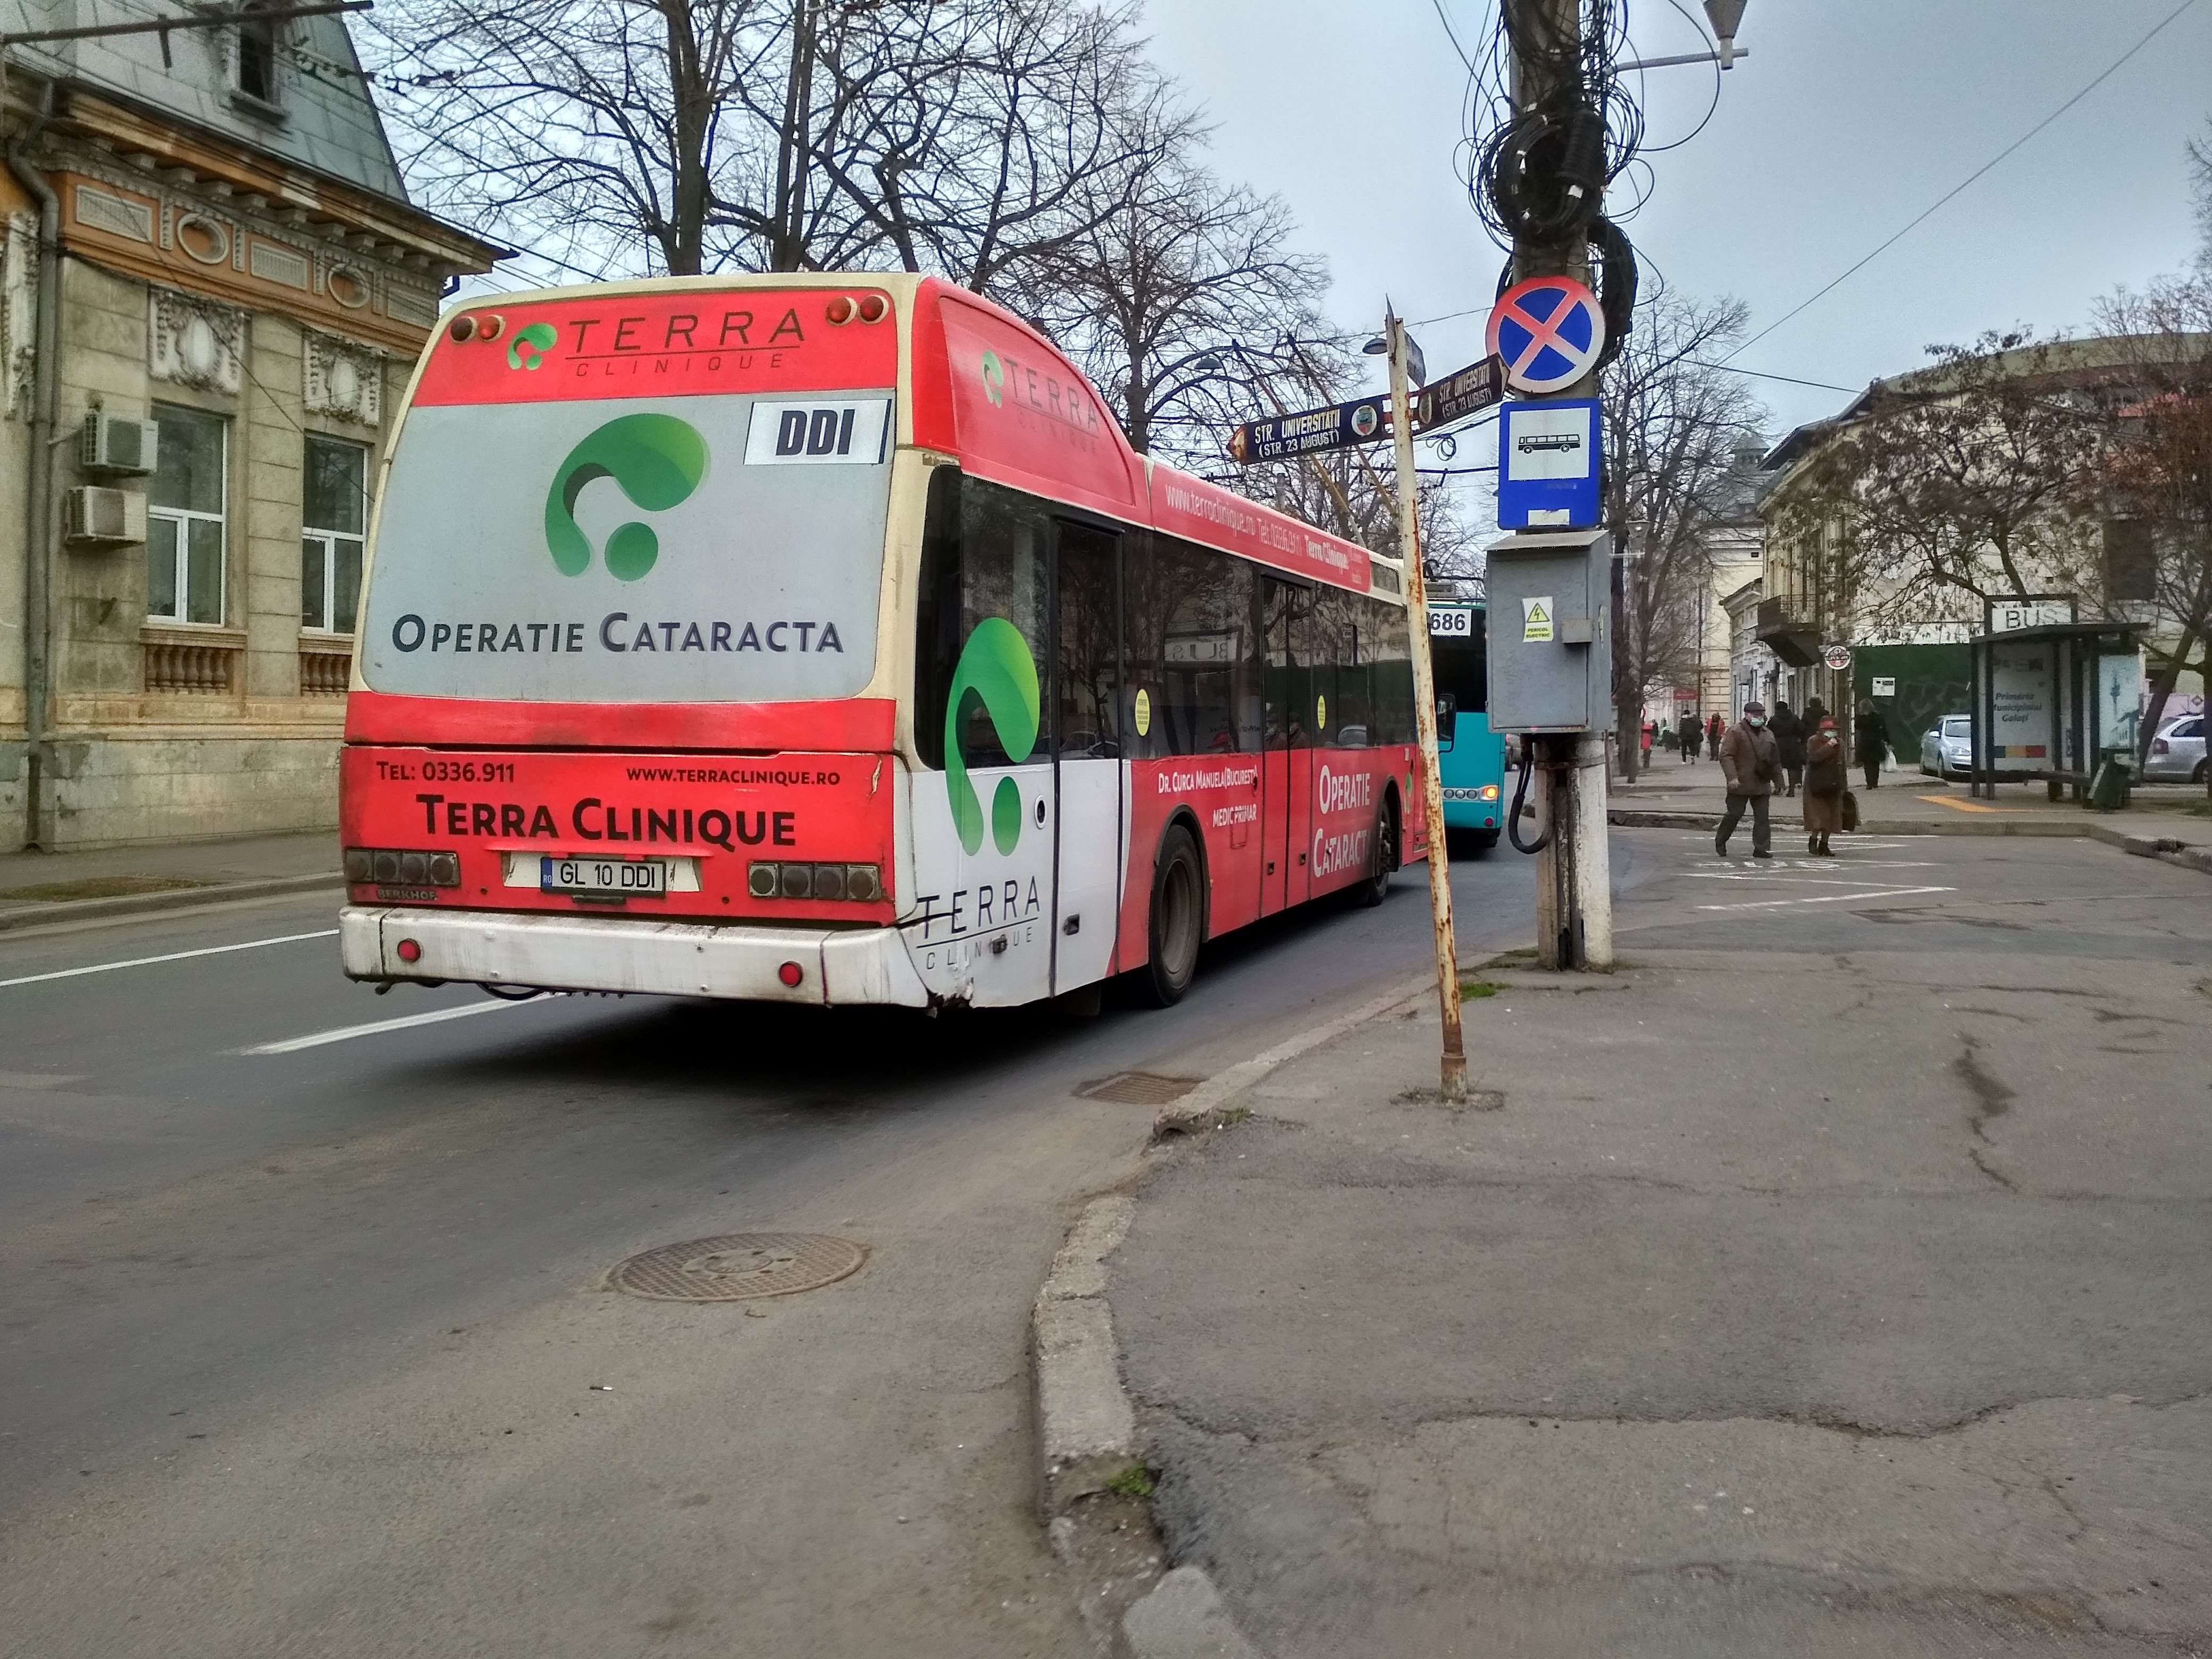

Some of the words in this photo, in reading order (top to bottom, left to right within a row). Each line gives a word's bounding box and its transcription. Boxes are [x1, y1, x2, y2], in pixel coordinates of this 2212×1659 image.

[569, 308, 805, 354] TERRA
[576, 353, 783, 377] CLINIQUE
[1004, 357, 1100, 434] TERRA
[1458, 397, 1467, 410] 23
[776, 409, 855, 456] DDI
[1255, 424, 1275, 444] STR.
[1259, 441, 1284, 459] (STR.
[1286, 439, 1298, 452] 23
[1301, 429, 1339, 450] AUGUST)
[1165, 484, 1256, 537] www.terraclinique.ro
[1304, 535, 1323, 562] Terra
[1322, 541, 1350, 575] Clinique
[392, 614, 584, 652] OPERATIE
[599, 612, 844, 653] CATARACTA
[2006, 608, 2058, 629] BUS
[376, 761, 415, 780] TEL:
[422, 761, 514, 782] 0336.911
[626, 768, 840, 786] WWW.TERRACLINIQUE.RO
[1159, 773, 1171, 793] DR.
[1172, 772, 1194, 792] CURCA
[1319, 765, 1370, 815] OPERATIE
[416, 794, 559, 838] TERRA
[572, 797, 795, 852] CLINIQUE
[1212, 808, 1234, 827] MEDIC
[1234, 803, 1257, 824] PRIMAR
[1314, 828, 1372, 878] CATARACT
[543, 874, 552, 883] RO
[560, 862, 585, 885] GL
[595, 864, 612, 886] 10
[622, 865, 655, 888] DDI
[917, 875, 1040, 939] TERRA
